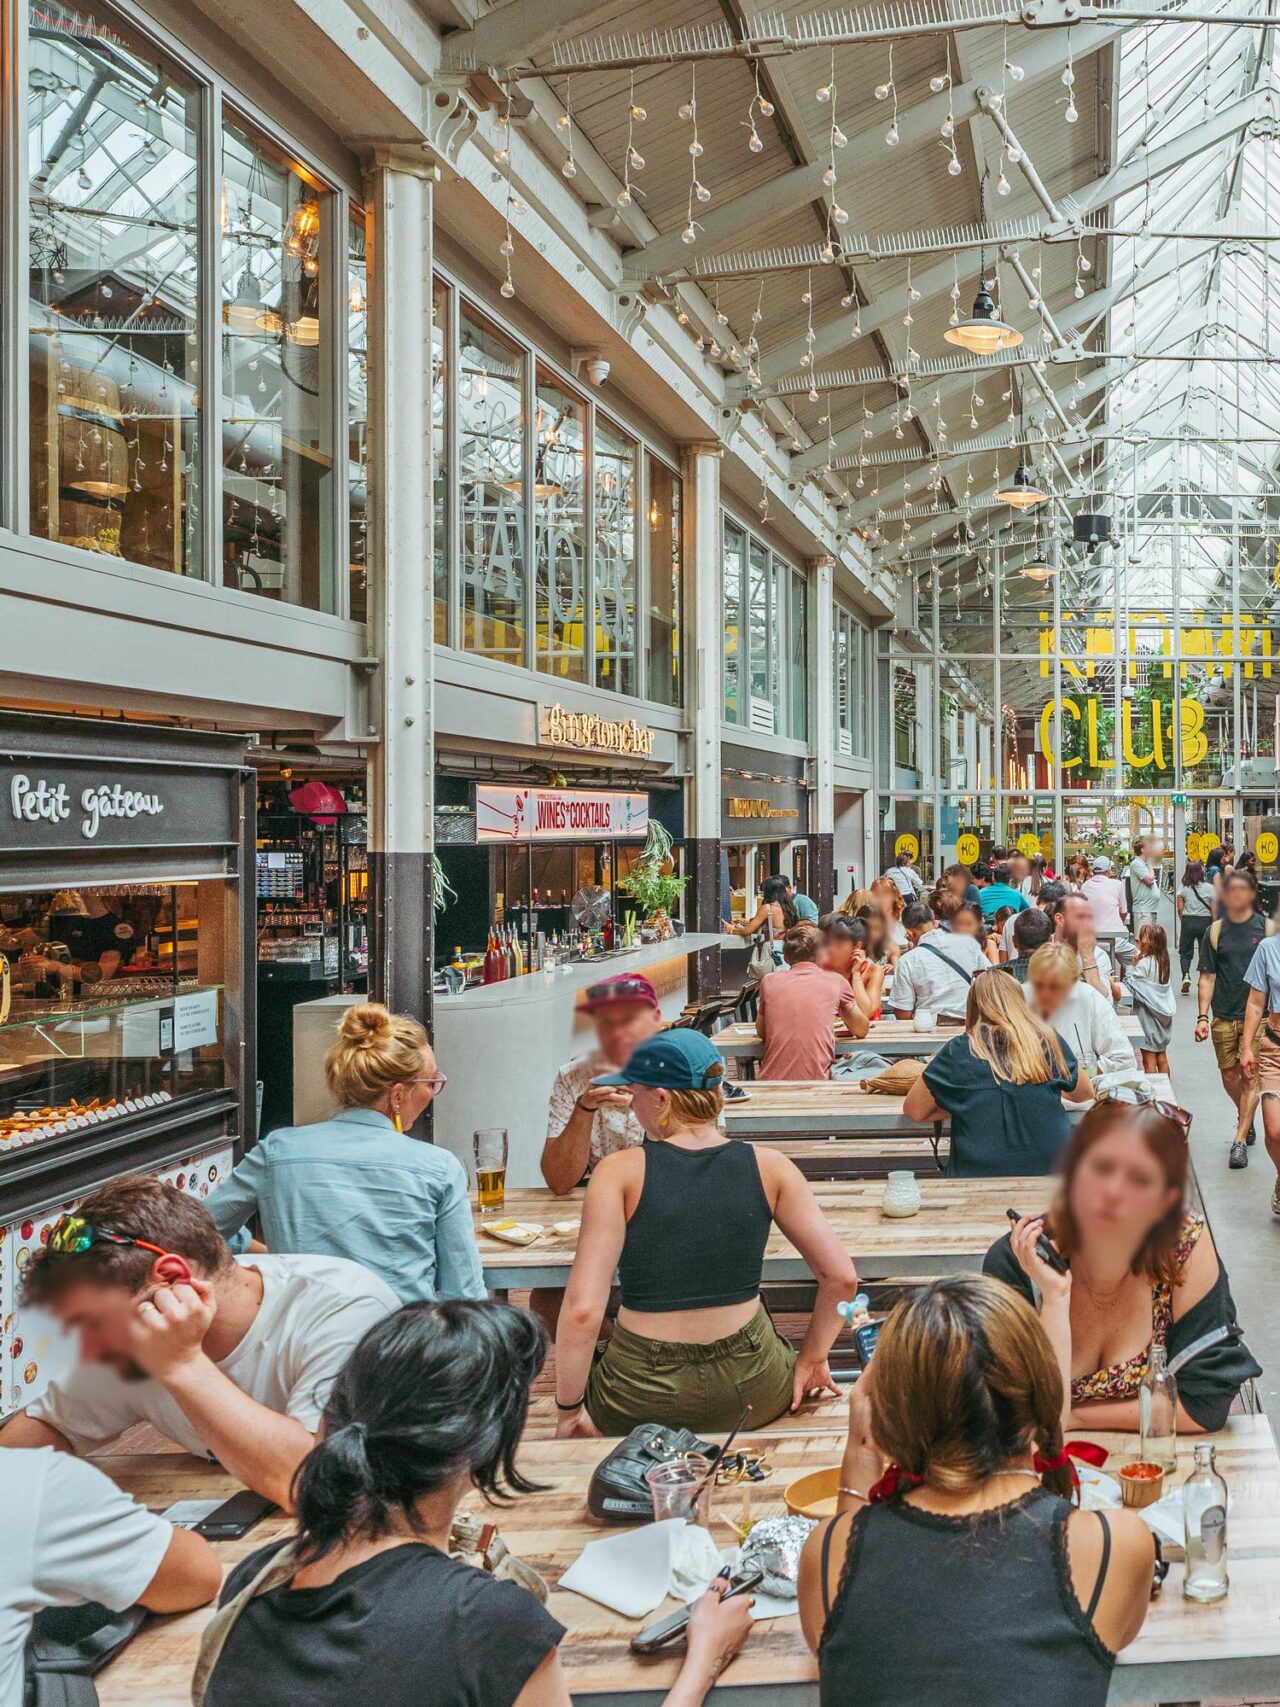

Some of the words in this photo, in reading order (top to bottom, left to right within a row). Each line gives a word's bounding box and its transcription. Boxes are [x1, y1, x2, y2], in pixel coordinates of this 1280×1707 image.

[1040, 697, 1208, 770] CLUB
[11, 774, 71, 823] Petit
[81, 783, 164, 838] gâteau
[1261, 842, 1274, 855] KC
